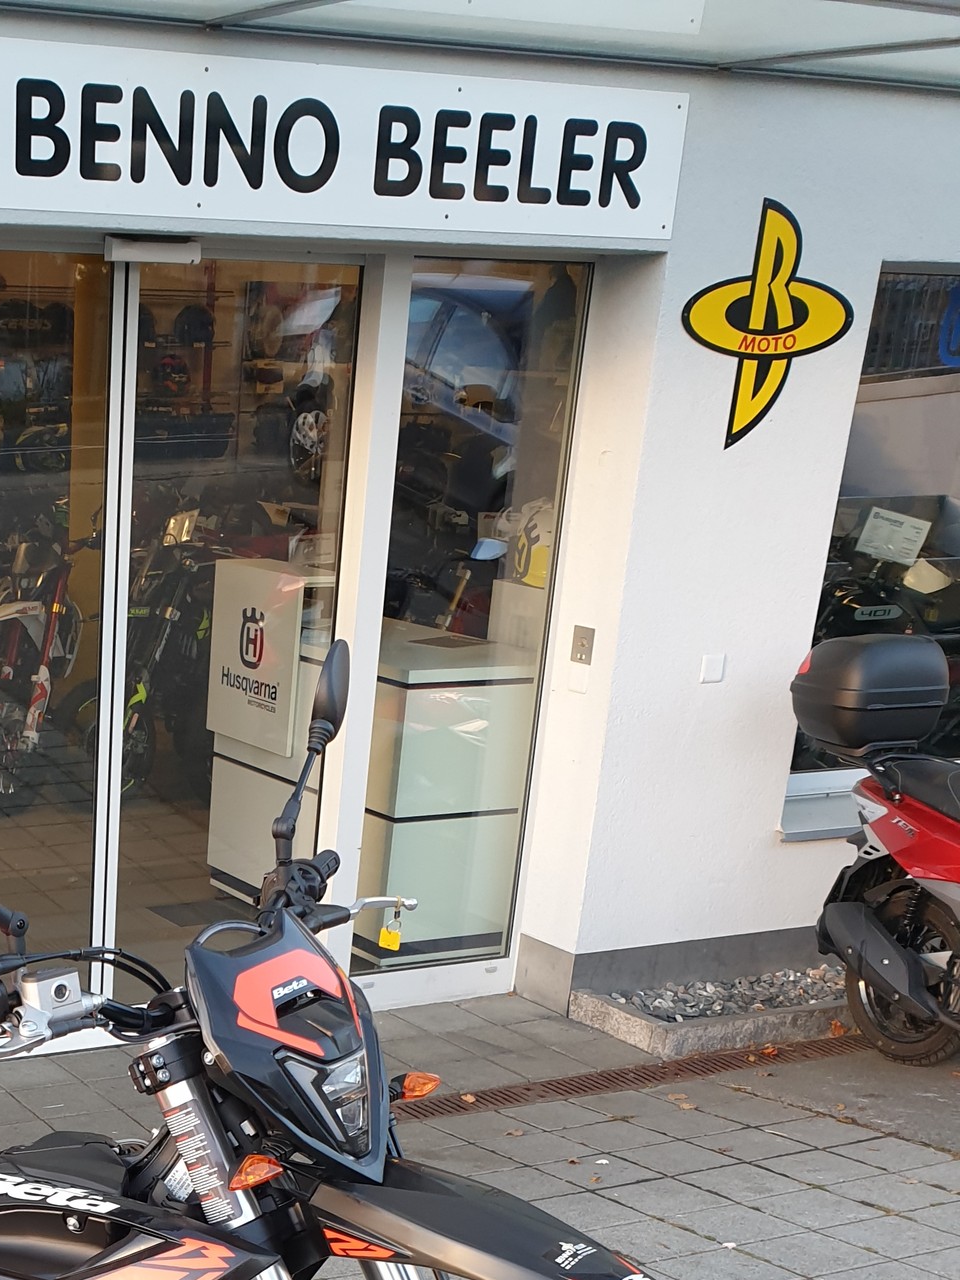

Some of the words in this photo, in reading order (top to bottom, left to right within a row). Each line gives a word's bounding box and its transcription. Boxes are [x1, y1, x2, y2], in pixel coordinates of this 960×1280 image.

[14, 77, 341, 194] BENNO
[373, 104, 648, 210] BEELER
[737, 333, 797, 353] MOTO
[860, 608, 892, 618] 401
[221, 665, 278, 701] Husqvarna
[272, 978, 308, 1000] Beta
